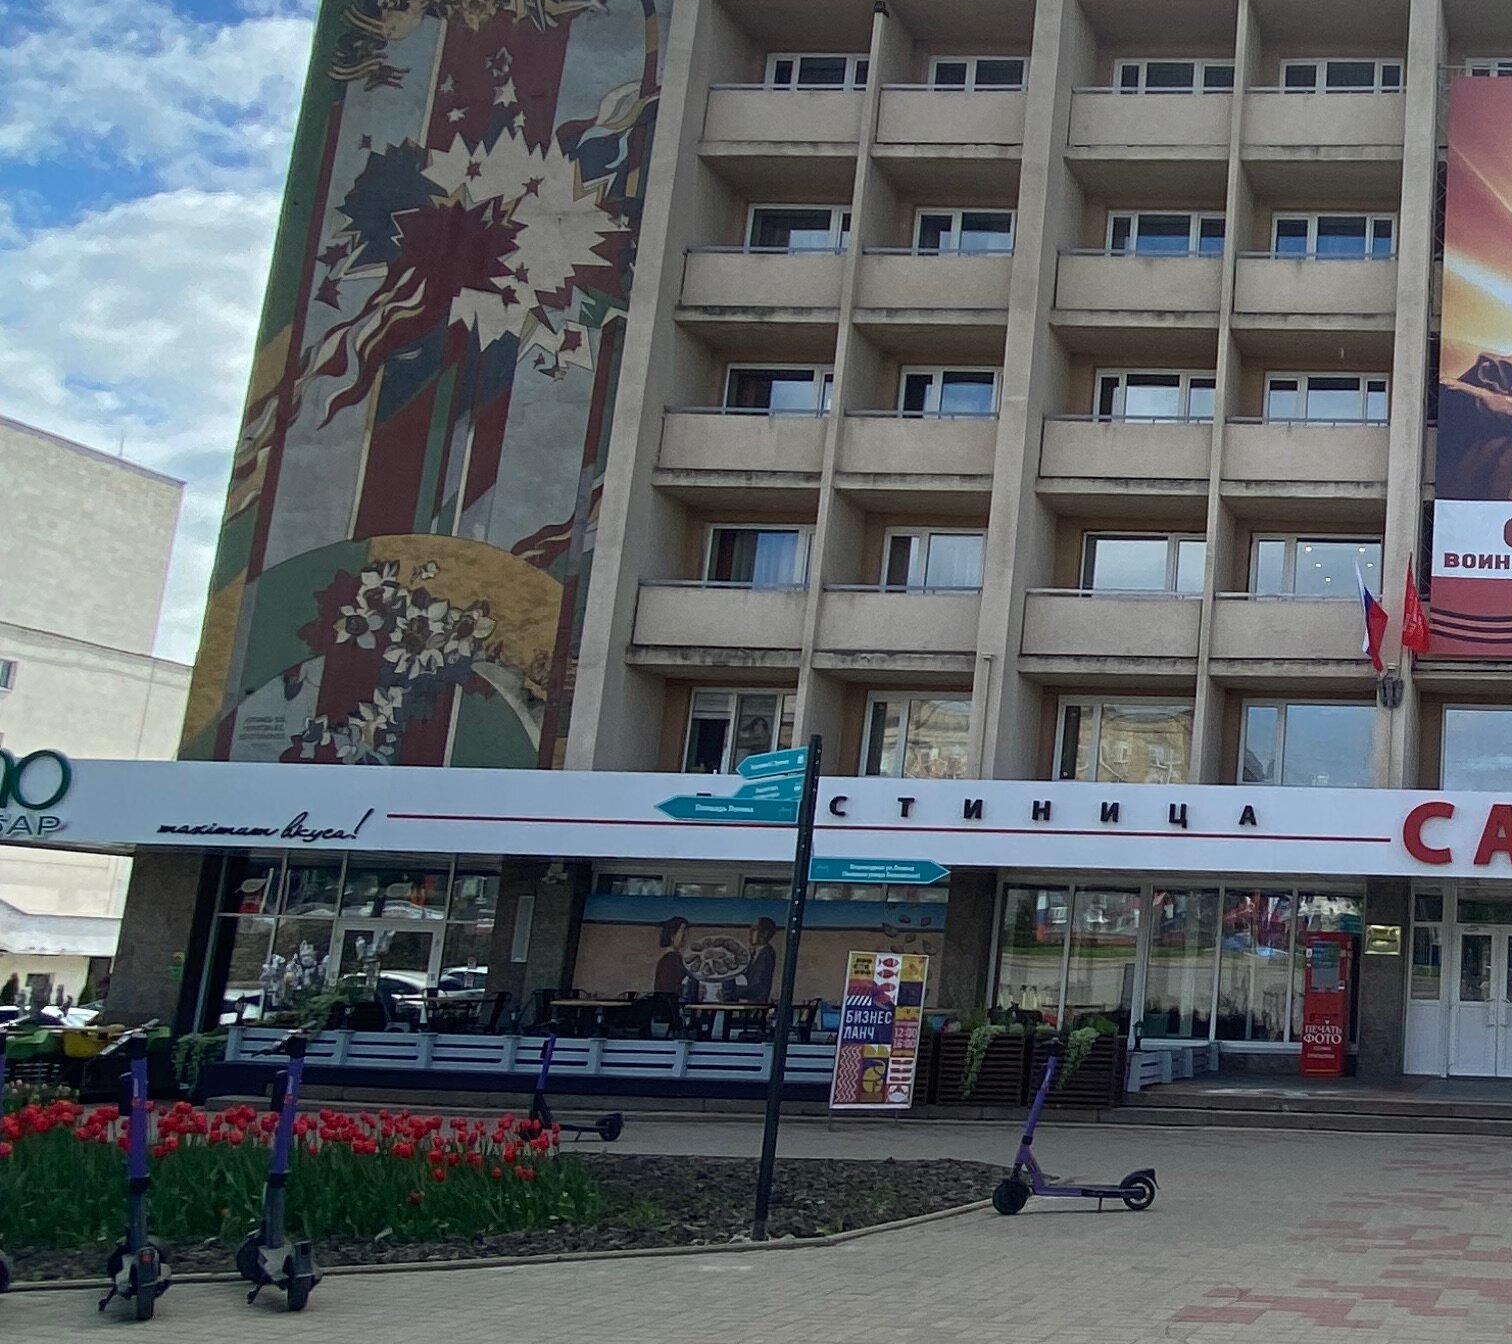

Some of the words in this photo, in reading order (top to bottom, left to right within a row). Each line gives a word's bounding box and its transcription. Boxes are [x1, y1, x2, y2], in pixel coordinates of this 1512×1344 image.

[697, 792, 1257, 830] СТИНИЦА
[846, 1010, 893, 1024] БИЗНЕС
[843, 1026, 875, 1040] ЛАНЧ
[1304, 1024, 1343, 1034] ПЕЧАТЬ
[1303, 1033, 1343, 1045] ФОТО
